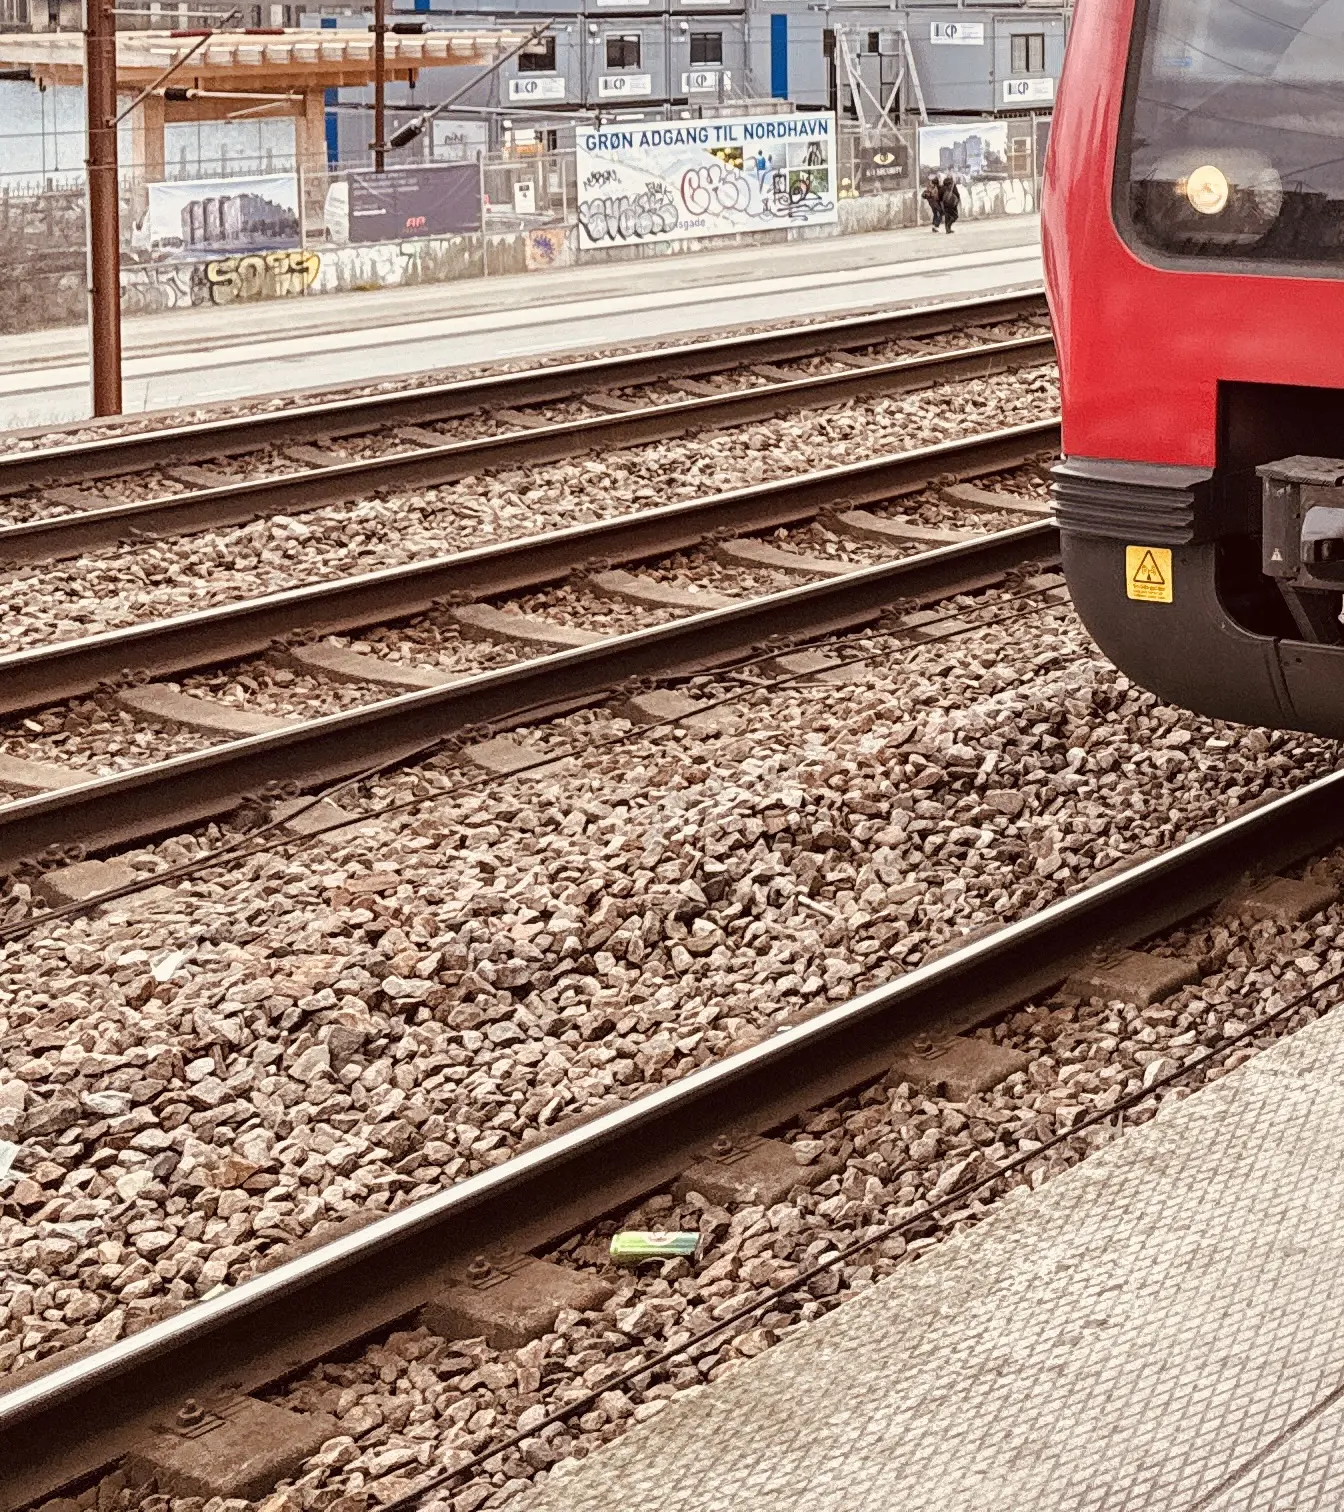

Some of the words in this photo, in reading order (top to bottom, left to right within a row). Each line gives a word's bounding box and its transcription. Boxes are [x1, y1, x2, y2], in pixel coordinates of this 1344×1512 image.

[586, 133, 633, 151] GRØN
[639, 127, 709, 148] ADGANG
[713, 125, 738, 142] TIL
[743, 119, 829, 141] NORDHAVN
